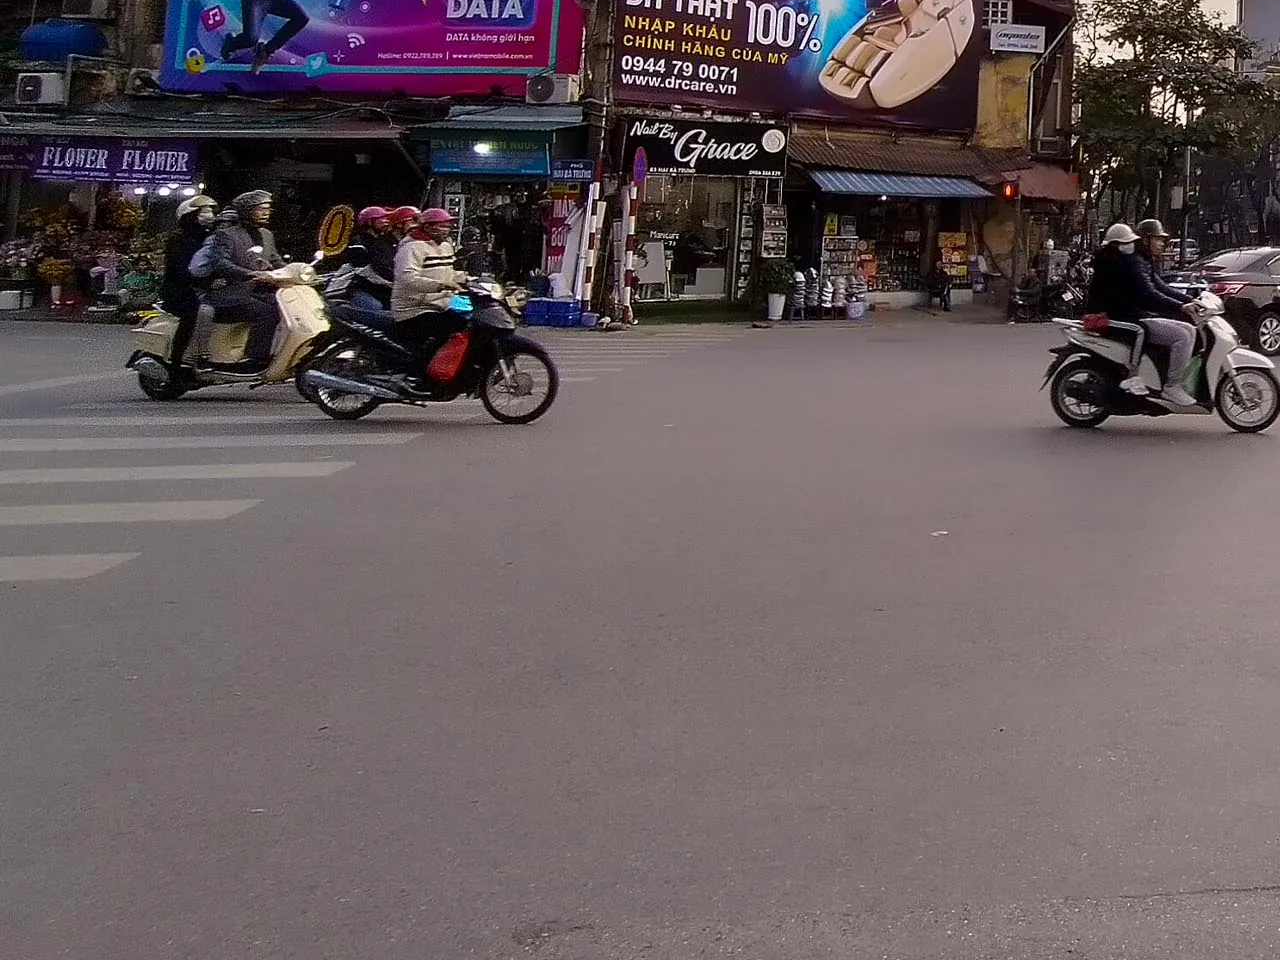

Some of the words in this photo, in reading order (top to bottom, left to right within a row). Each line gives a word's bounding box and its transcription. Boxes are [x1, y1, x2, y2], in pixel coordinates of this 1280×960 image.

[446, 33, 469, 41] DATA
[471, 33, 498, 43] không
[499, 33, 516, 43] giới
[518, 33, 535, 44] hạn
[745, 0, 823, 53] 100%
[623, 34, 674, 51] CHÍNH
[682, 41, 726, 58] HÃNG
[732, 47, 762, 63] CỦA
[768, 52, 788, 65] MỸ
[622, 55, 666, 73] 0944
[672, 61, 693, 76] 79
[699, 64, 738, 82] 0071
[621, 73, 737, 95] www.drcare.vn
[630, 120, 658, 136] Nail
[659, 123, 677, 144] By
[42, 146, 108, 169] FLOWER
[121, 149, 189, 172] FLOWER
[674, 129, 758, 168] Grace
